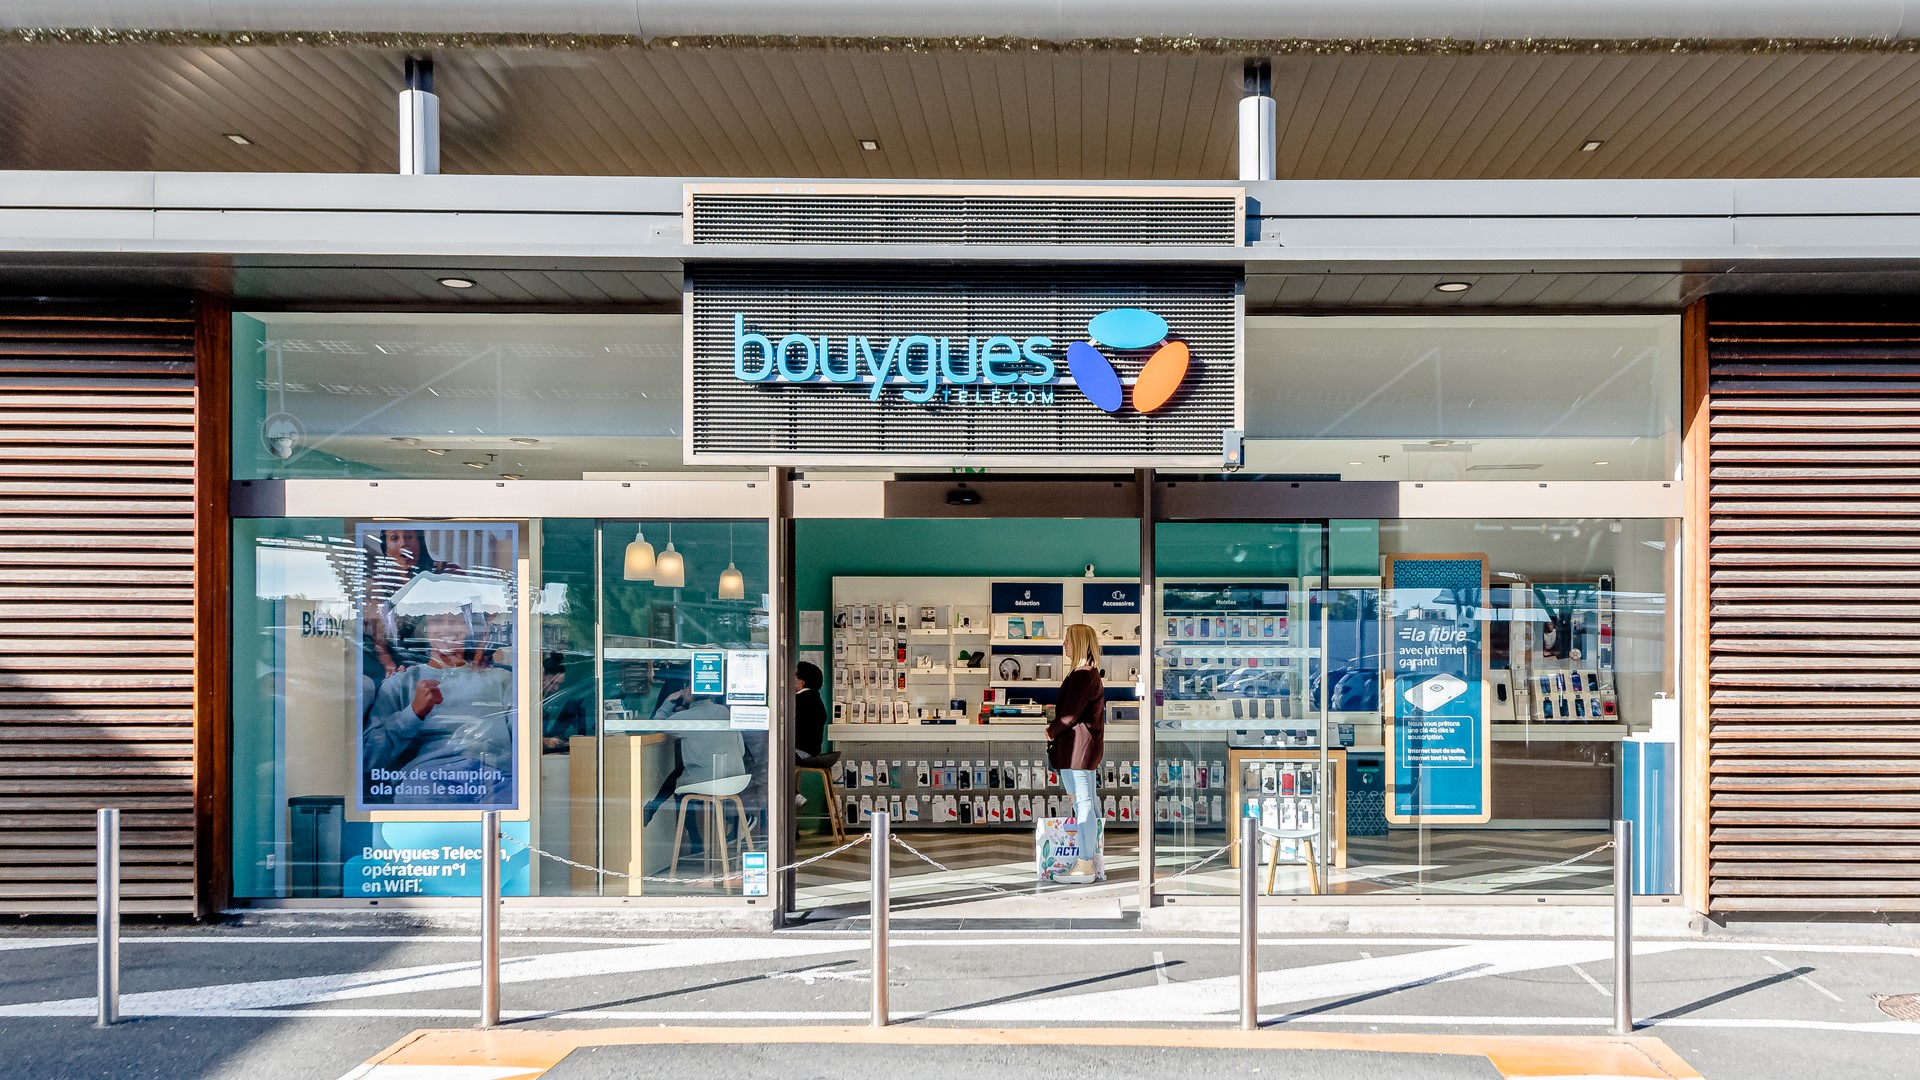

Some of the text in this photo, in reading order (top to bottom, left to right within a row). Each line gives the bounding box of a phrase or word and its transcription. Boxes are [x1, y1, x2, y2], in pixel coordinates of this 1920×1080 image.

[734, 312, 1055, 402] bouygues
[942, 391, 1054, 404] TELECOM
[1411, 627, 1467, 642] la fibre
[1398, 645, 1468, 655] avec internet
[1398, 656, 1438, 669] garanti
[1437, 720, 1461, 728] prêtons
[371, 768, 506, 783] Bbox de champion,
[370, 782, 487, 796] ola dans le salon
[362, 846, 511, 863] Bouygues Telec,
[1055, 846, 1080, 857] ACTI
[362, 862, 440, 879] opérateur
[361, 881, 381, 893] en
